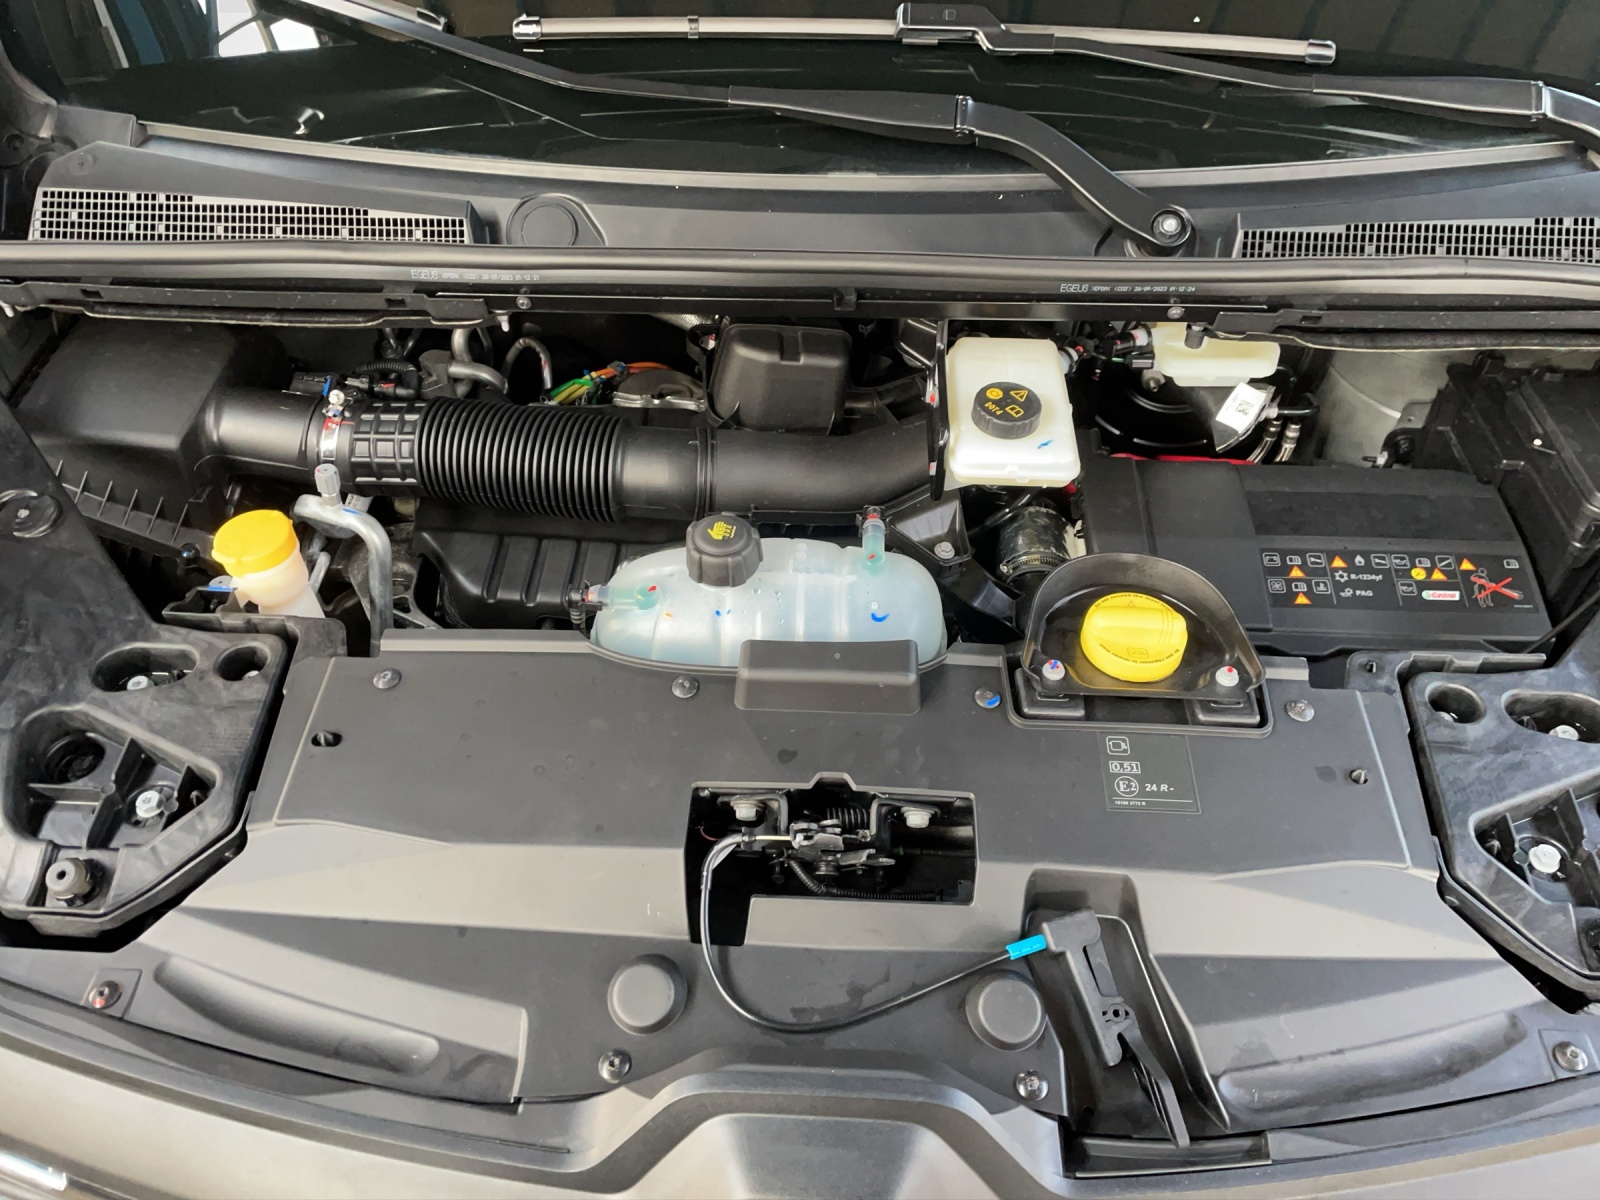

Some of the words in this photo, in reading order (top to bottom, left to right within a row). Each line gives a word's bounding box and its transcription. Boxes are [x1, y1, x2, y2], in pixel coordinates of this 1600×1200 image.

[1060, 283, 1089, 293] EGEUS
[1111, 762, 1139, 773] 0,51
[1144, 783, 1158, 792] 24
